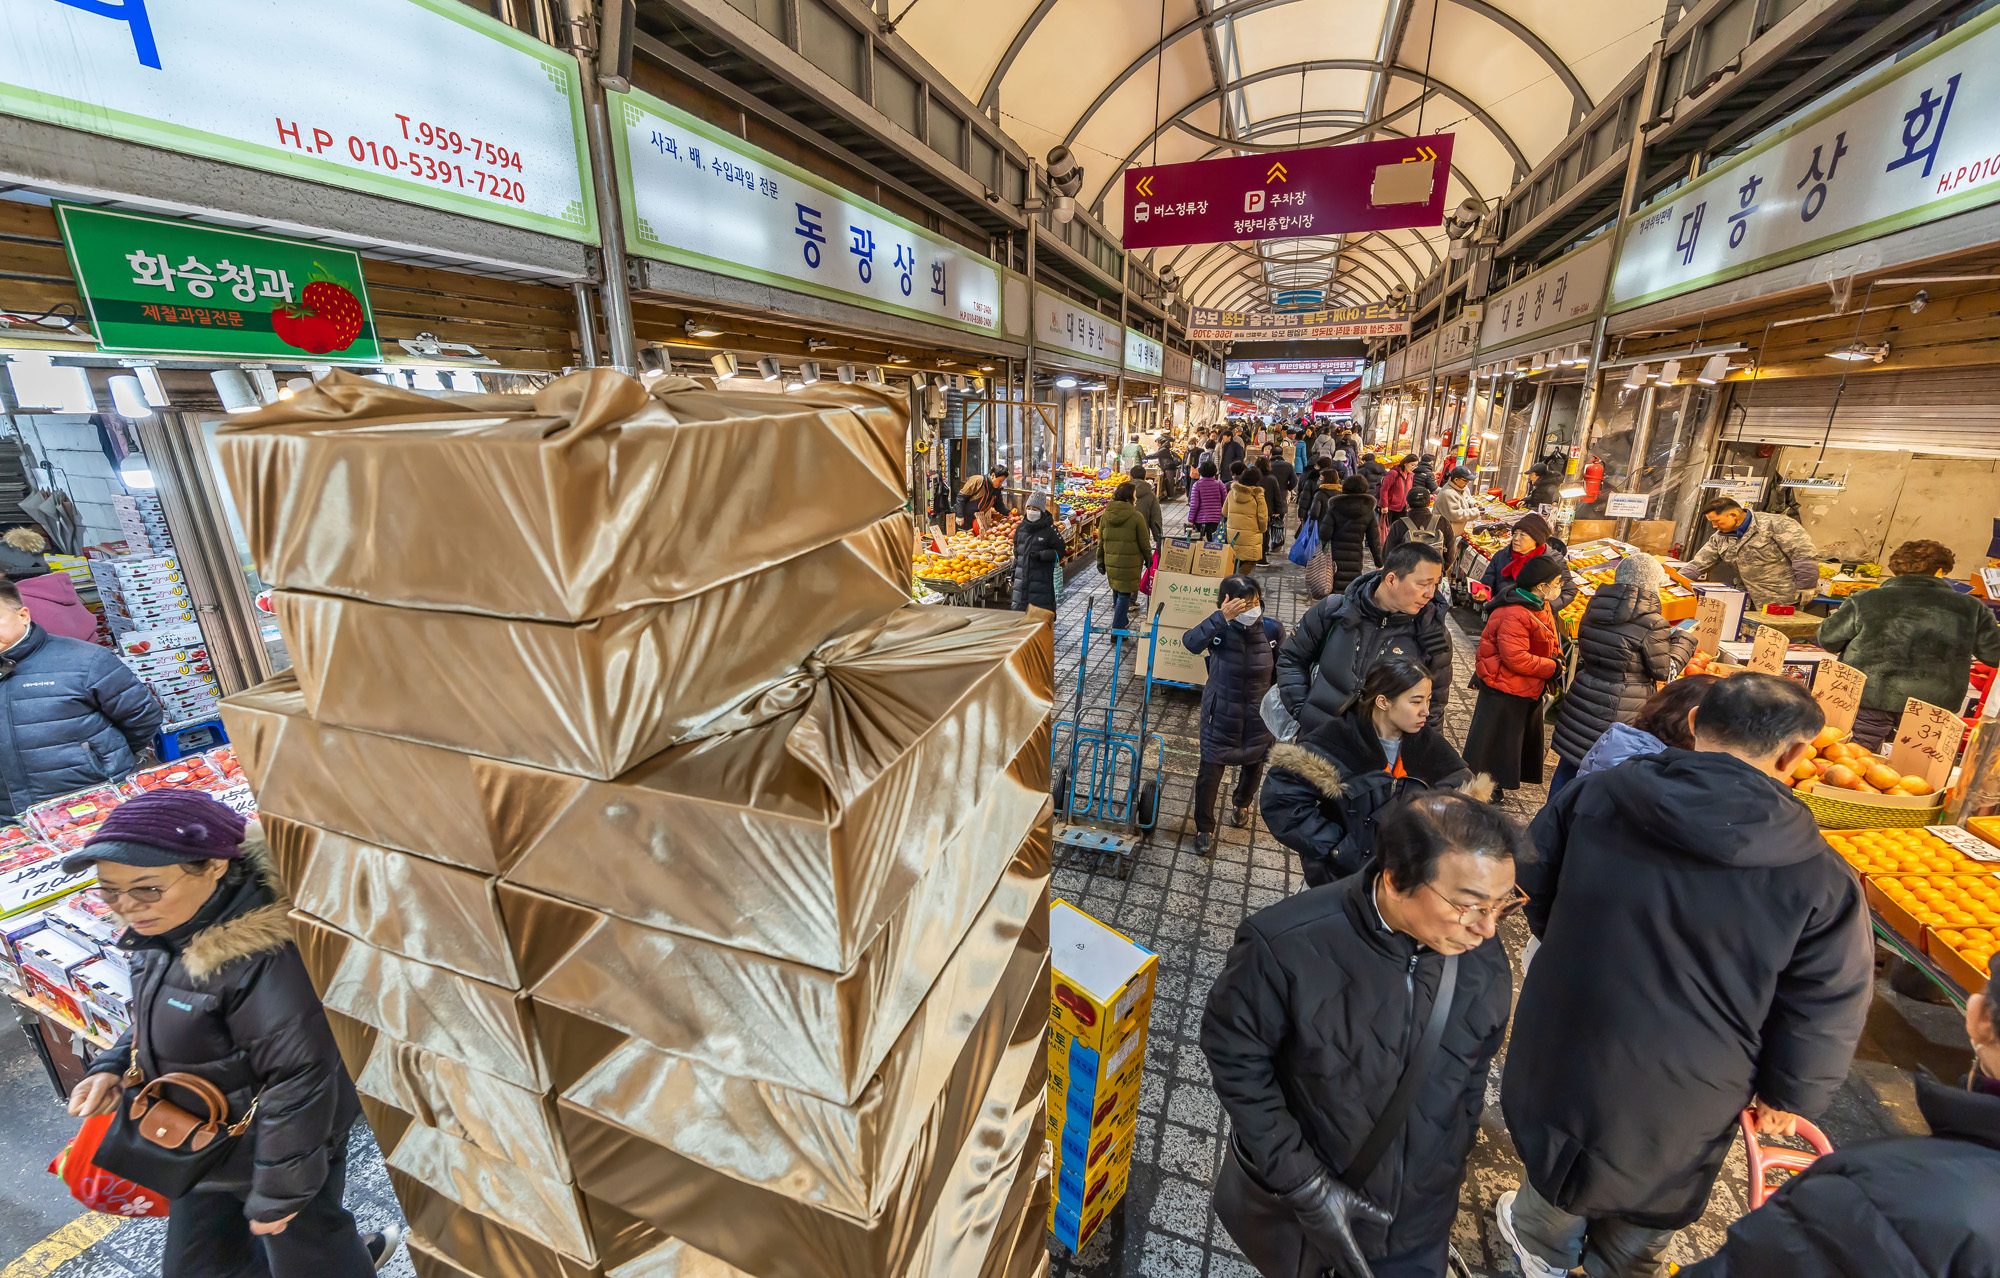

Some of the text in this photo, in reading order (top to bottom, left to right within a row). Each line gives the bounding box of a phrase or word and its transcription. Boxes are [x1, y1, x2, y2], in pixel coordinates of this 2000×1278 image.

[276, 117, 525, 203] H.P 010-5391-7220
[395, 113, 523, 174] T.959-7594
[651, 130, 779, 200] 사과, 배, 수입과일 전문
[1676, 72, 1963, 267] 대흥상회
[1154, 200, 1208, 218] 버스정류장
[1233, 214, 1314, 234] 청량리종합시장
[1270, 191, 1307, 208] 주차장
[125, 250, 294, 303] 화승청과
[795, 201, 947, 307] 동광상회
[141, 304, 244, 327] 제철과일전문
